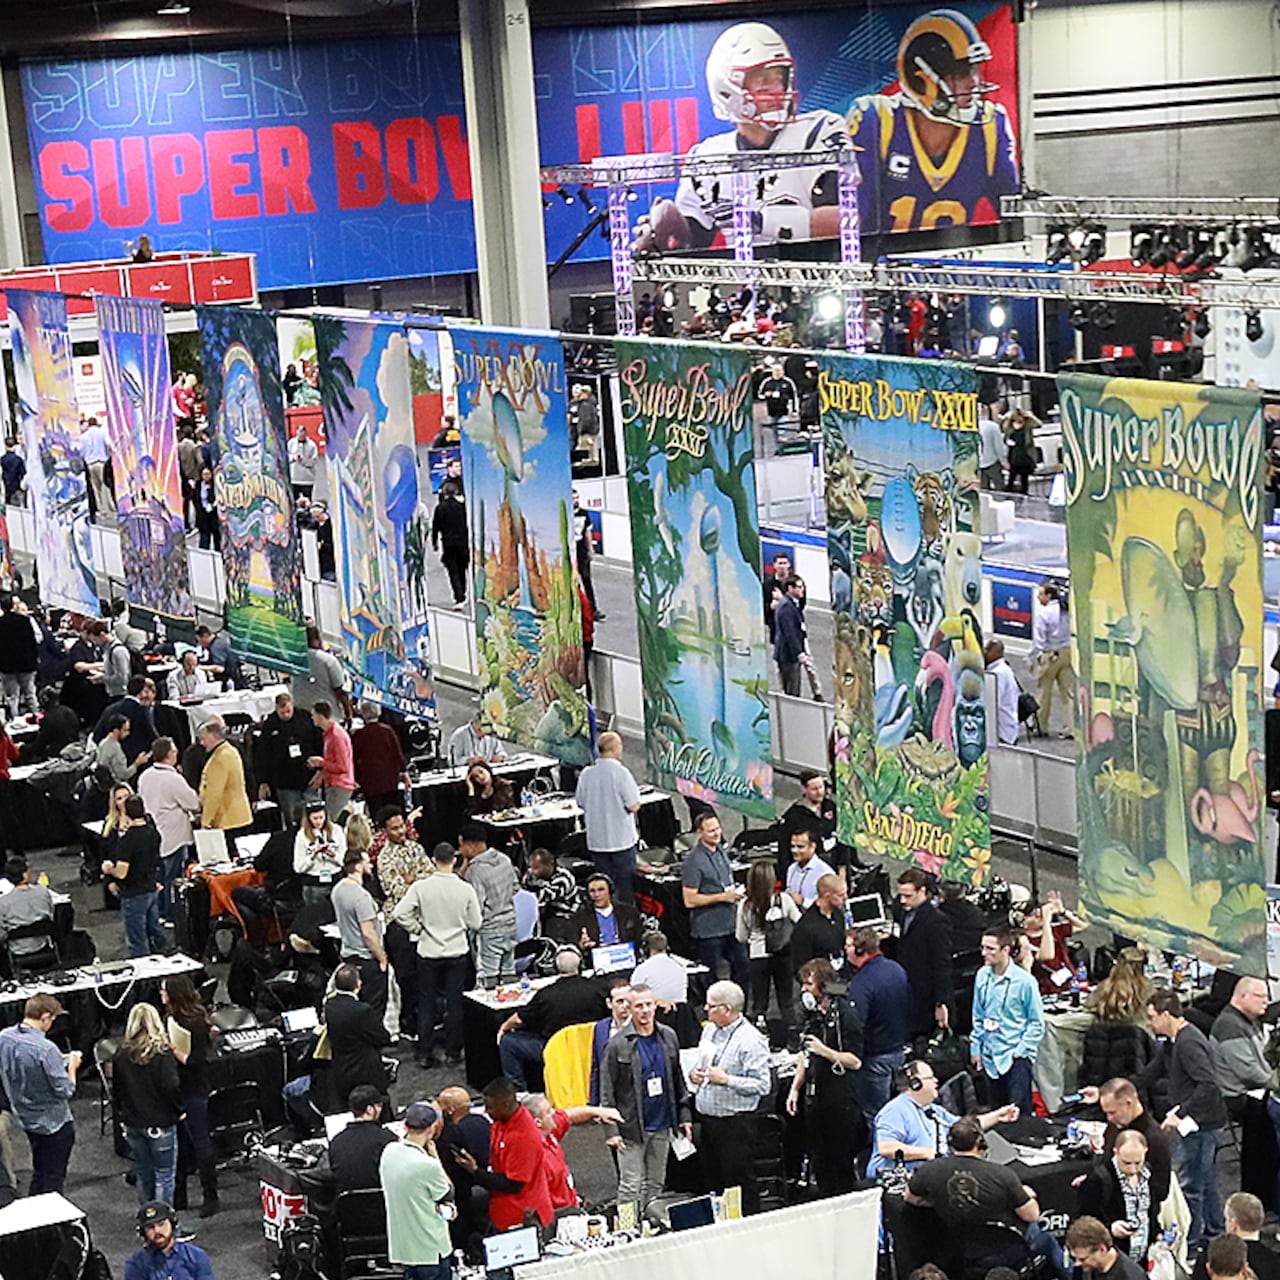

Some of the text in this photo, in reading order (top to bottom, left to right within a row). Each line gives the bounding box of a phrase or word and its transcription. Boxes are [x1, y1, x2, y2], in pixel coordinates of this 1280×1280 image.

[38, 125, 317, 232] SUPER
[453, 349, 564, 393] SUPER BOWL
[622, 358, 687, 441] Super
[1060, 388, 1265, 532] Super Bowl
[900, 811, 953, 856] DIEGO
